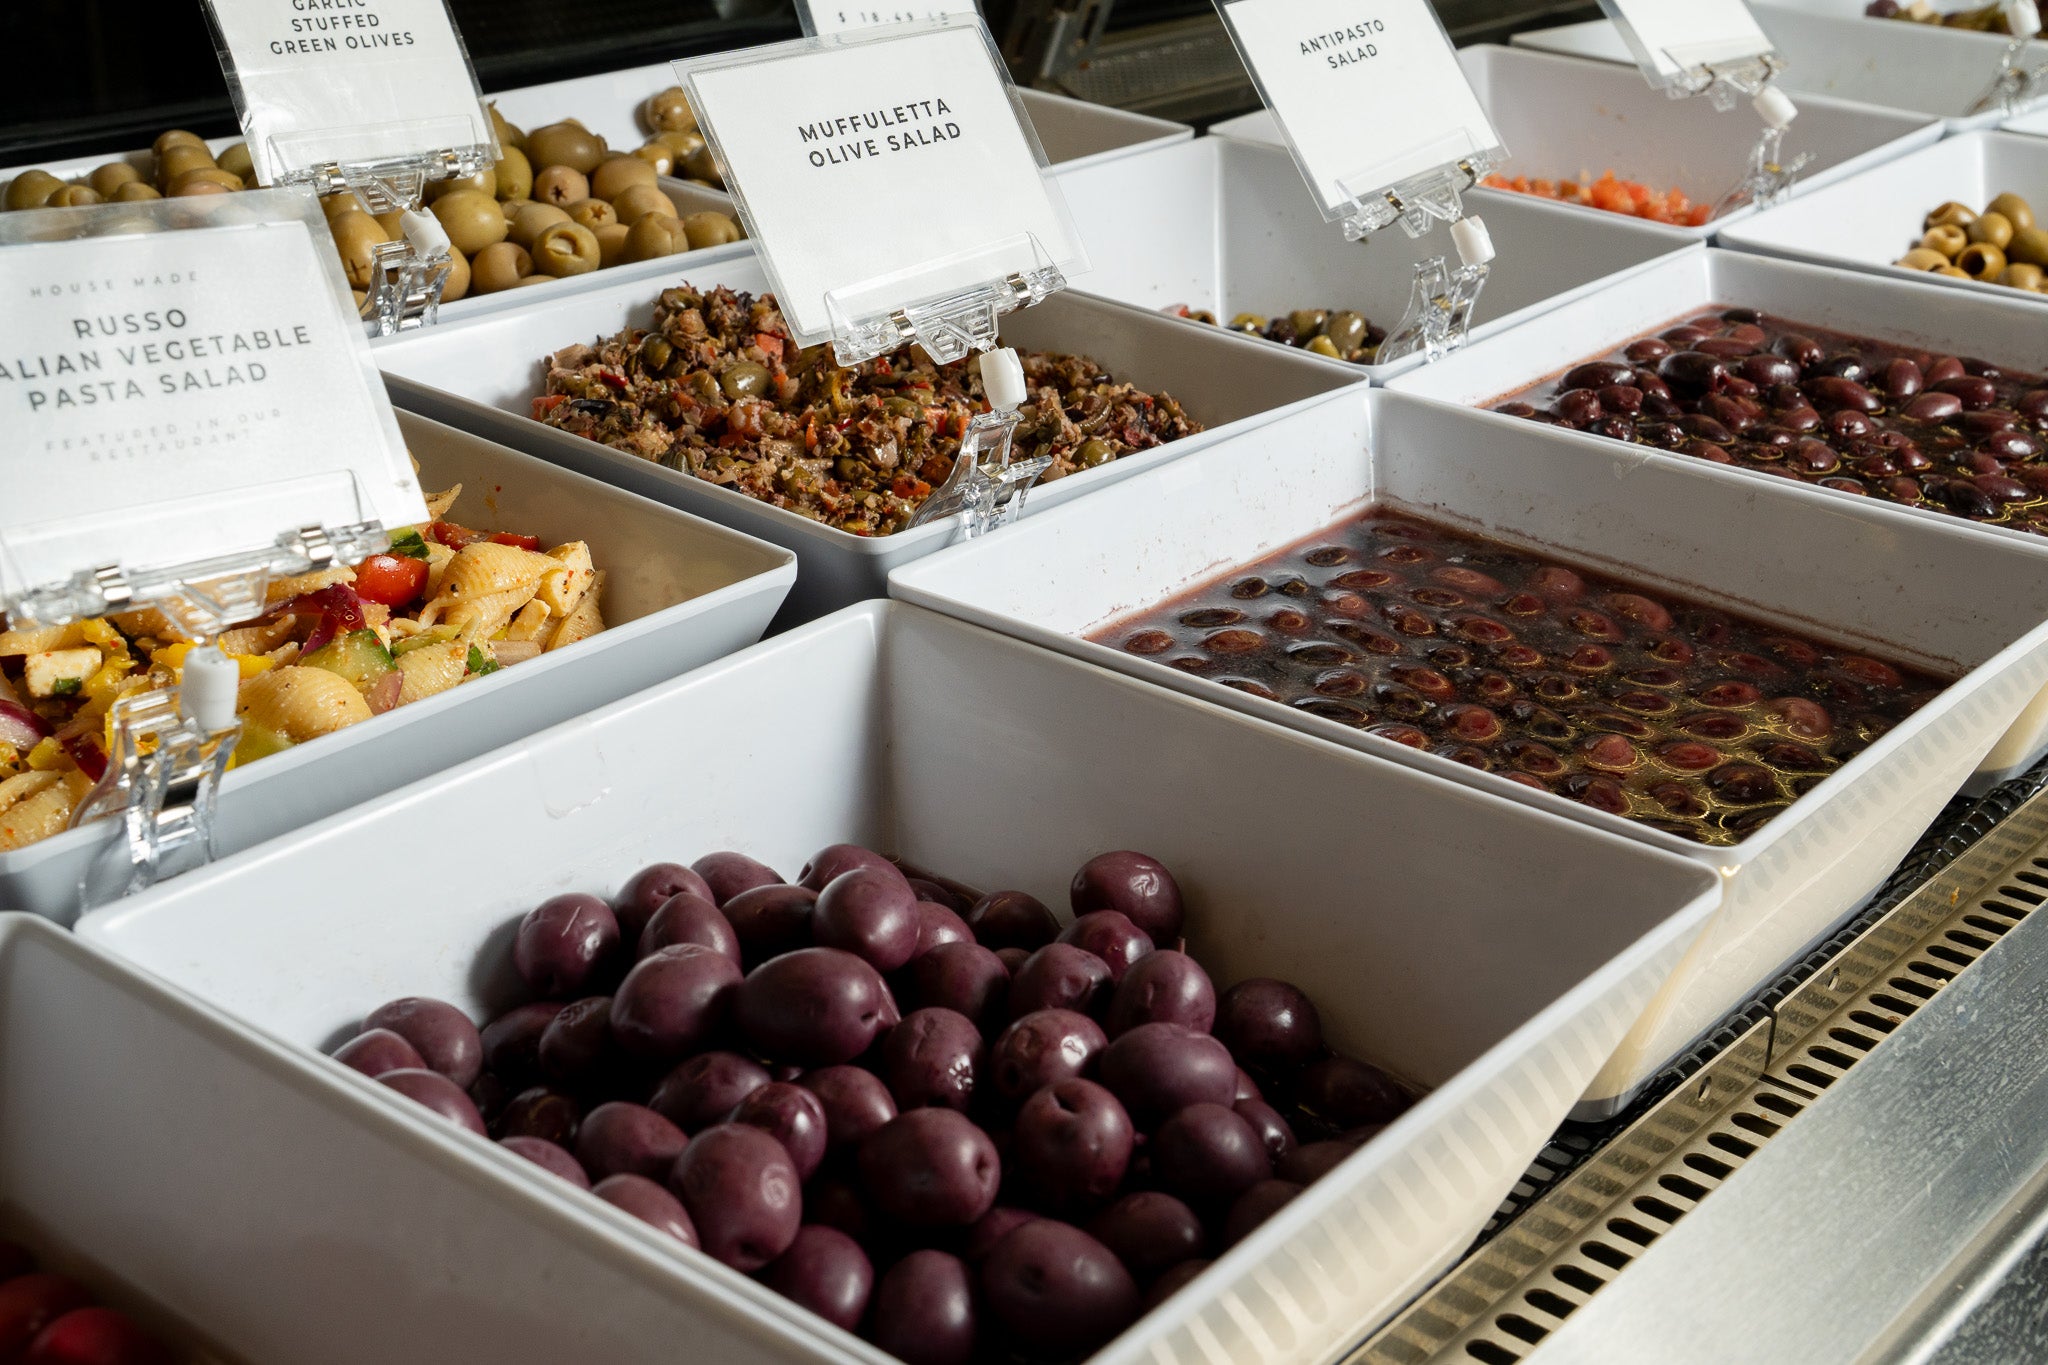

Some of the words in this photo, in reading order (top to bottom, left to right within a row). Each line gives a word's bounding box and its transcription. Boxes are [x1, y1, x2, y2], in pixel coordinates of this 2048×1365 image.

[291, 14, 379, 32] STUFFED
[838, 11, 846, 23] $
[270, 37, 337, 55] GREEN
[345, 32, 415, 49] OLIVES
[1300, 19, 1385, 55] ANTIPASTO
[1327, 44, 1378, 69] SALAD
[798, 98, 951, 143] MUFFULETTA
[809, 138, 880, 168] OLIVE
[887, 122, 961, 151] SALAD
[30, 279, 115, 298] HOUSE
[134, 271, 199, 289] MADE
[73, 309, 187, 338] RUSSO
[117, 325, 311, 367] VEGETABLE
[28, 379, 145, 411] PASTA
[160, 362, 267, 394] SALAD
[45, 423, 178, 452] FEATURED
[196, 417, 219, 431] IN
[238, 408, 282, 423] OUR
[90, 428, 251, 462] RESTAURANT
